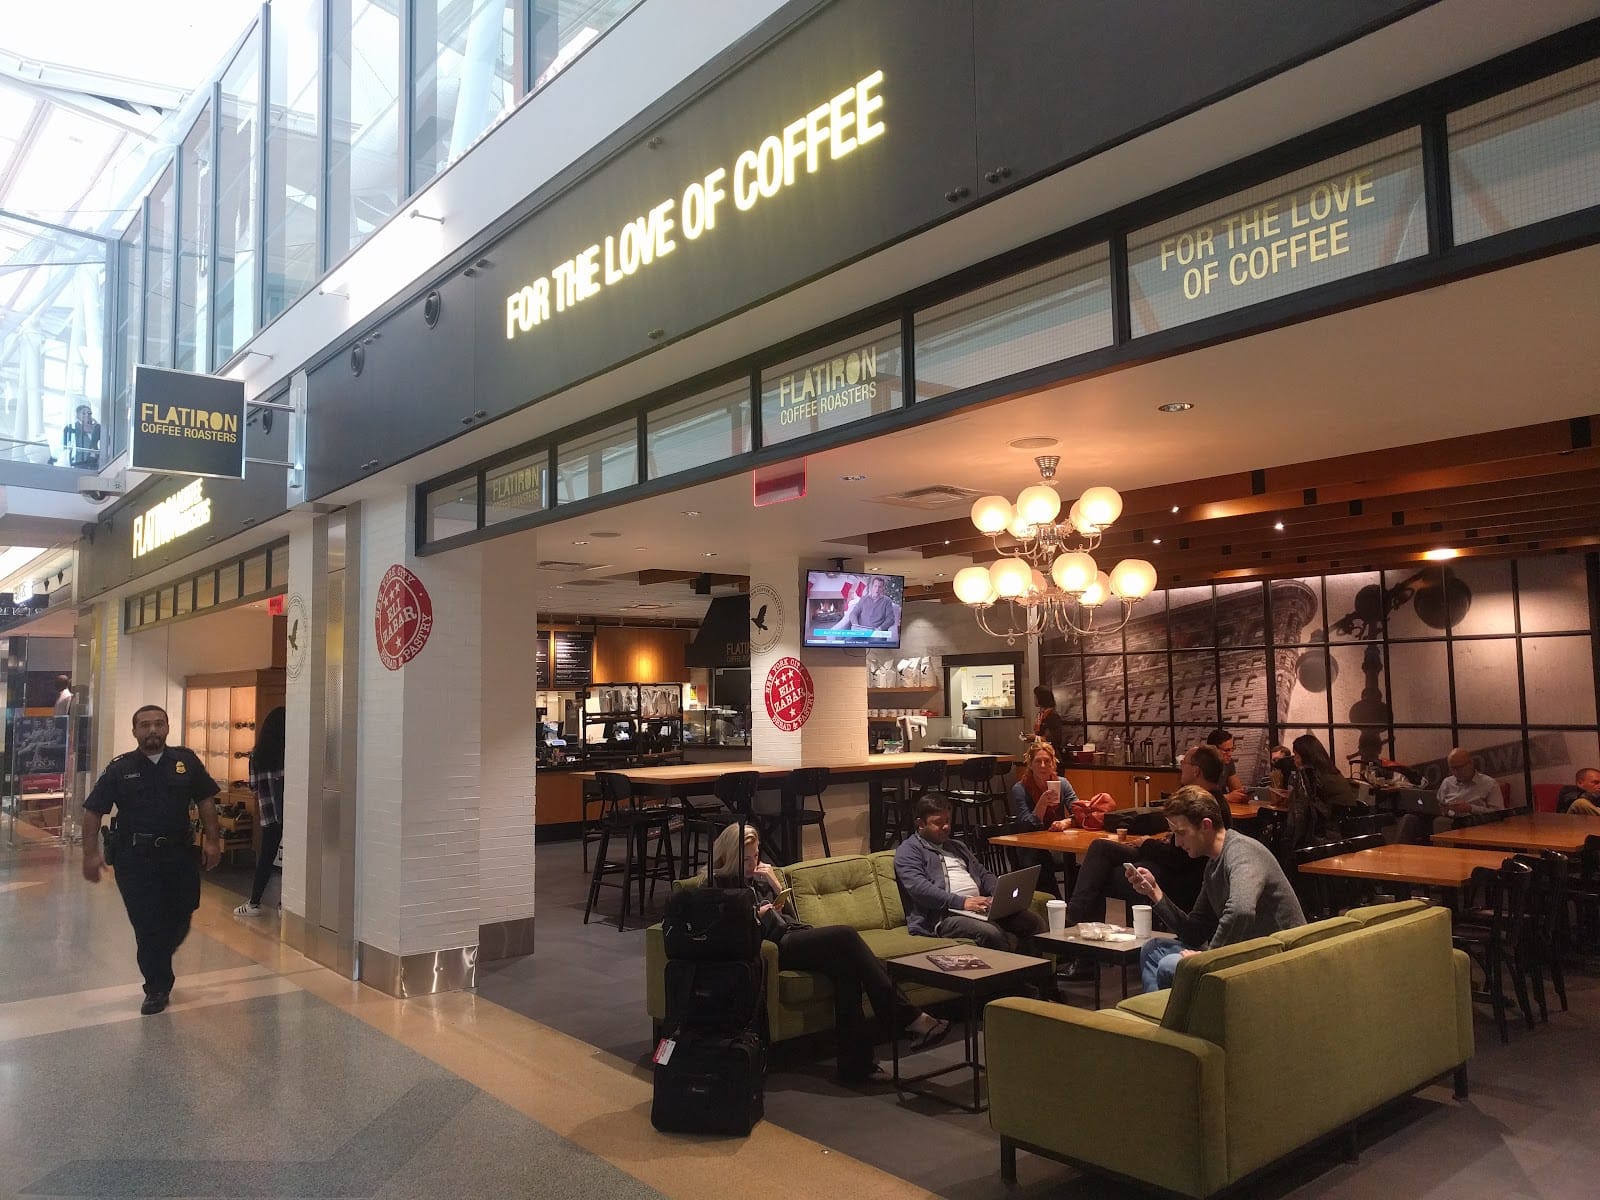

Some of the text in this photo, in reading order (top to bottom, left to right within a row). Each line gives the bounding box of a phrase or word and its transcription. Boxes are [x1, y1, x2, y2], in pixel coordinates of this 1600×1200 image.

[506, 69, 886, 340] FOR THE LOVE OF COFFEE
[1161, 171, 1375, 271] FOR THE LOVE
[1183, 219, 1350, 301] OF COFFEE
[779, 346, 877, 408] FLATIRON
[141, 402, 237, 433] FLATIRON
[780, 381, 877, 426] COFFEE ROASTERS
[141, 422, 237, 443] COFFEE ROASTERS
[382, 606, 417, 645] ZABAR
[387, 598, 401, 620] ELI
[403, 613, 432, 661] PASTRY
[772, 659, 788, 672] YORK
[774, 687, 806, 713] ZABAR
[778, 681, 796, 698] ELI
[771, 714, 792, 731] BREAD
[798, 691, 814, 724] PASTRY
